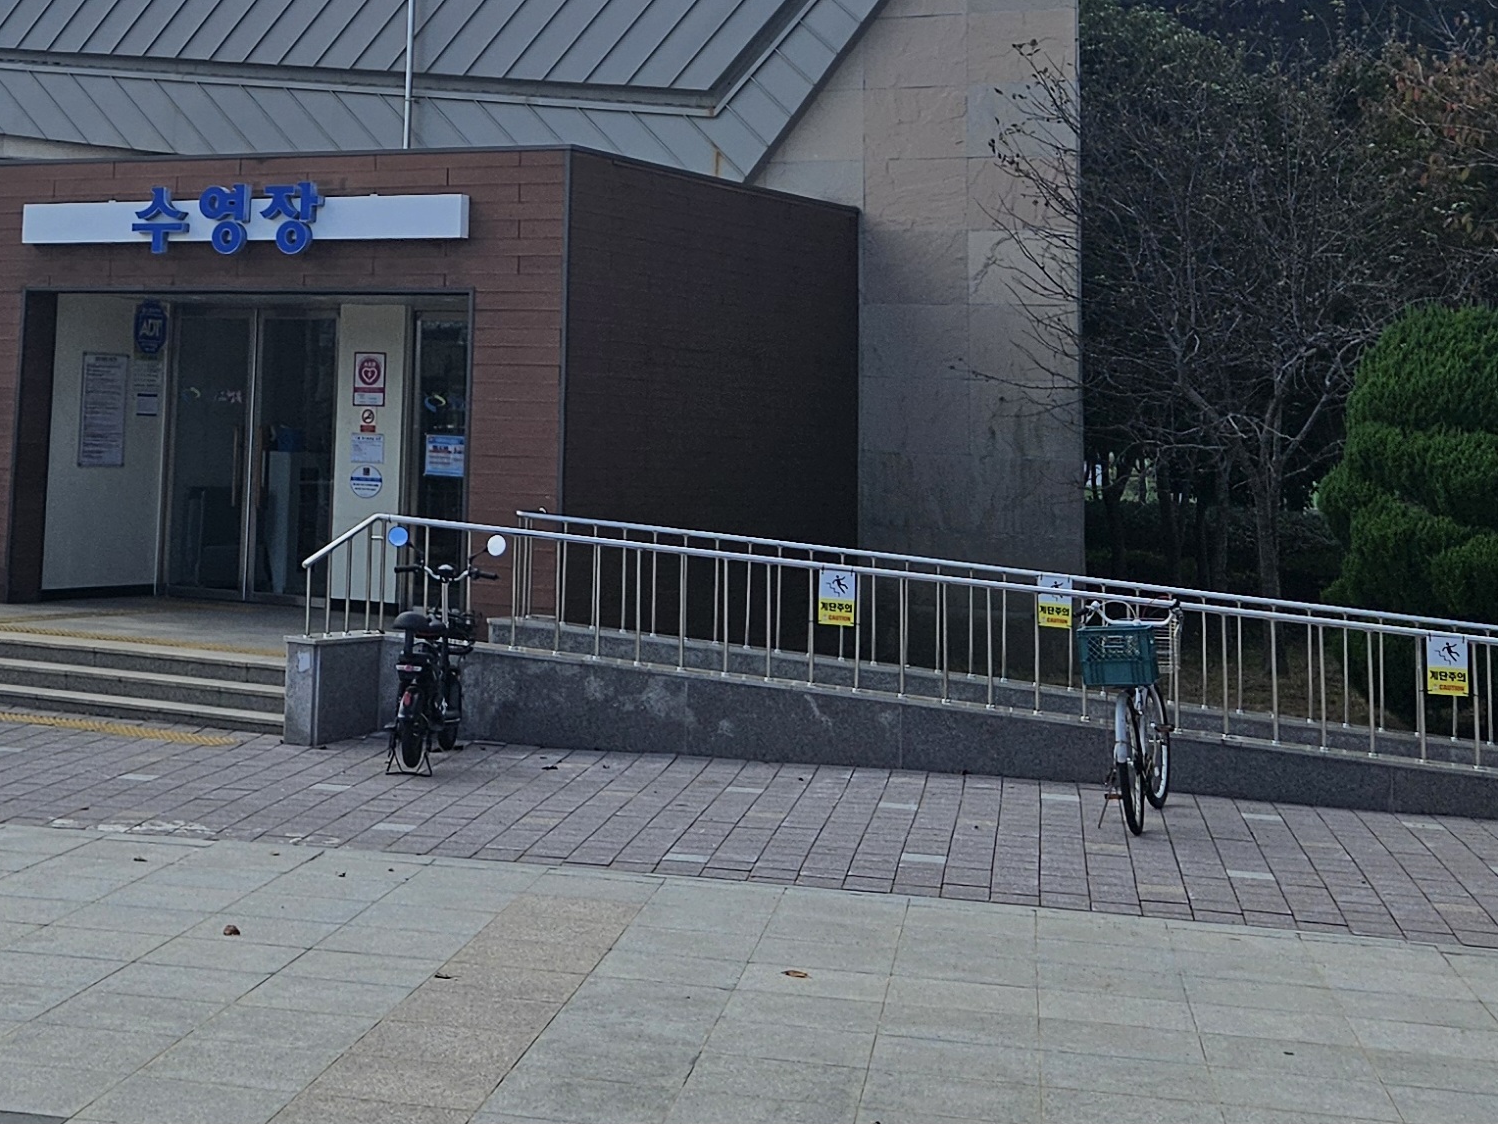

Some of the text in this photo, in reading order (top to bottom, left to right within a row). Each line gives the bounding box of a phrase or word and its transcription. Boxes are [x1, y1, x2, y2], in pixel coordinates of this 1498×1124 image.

[131, 181, 325, 255] 수영장
[139, 319, 163, 336] ADT
[820, 601, 853, 613] 계단주의
[1039, 605, 1070, 617] 계단주의
[828, 614, 851, 622] CAUTION
[1429, 670, 1466, 683] 계단주의
